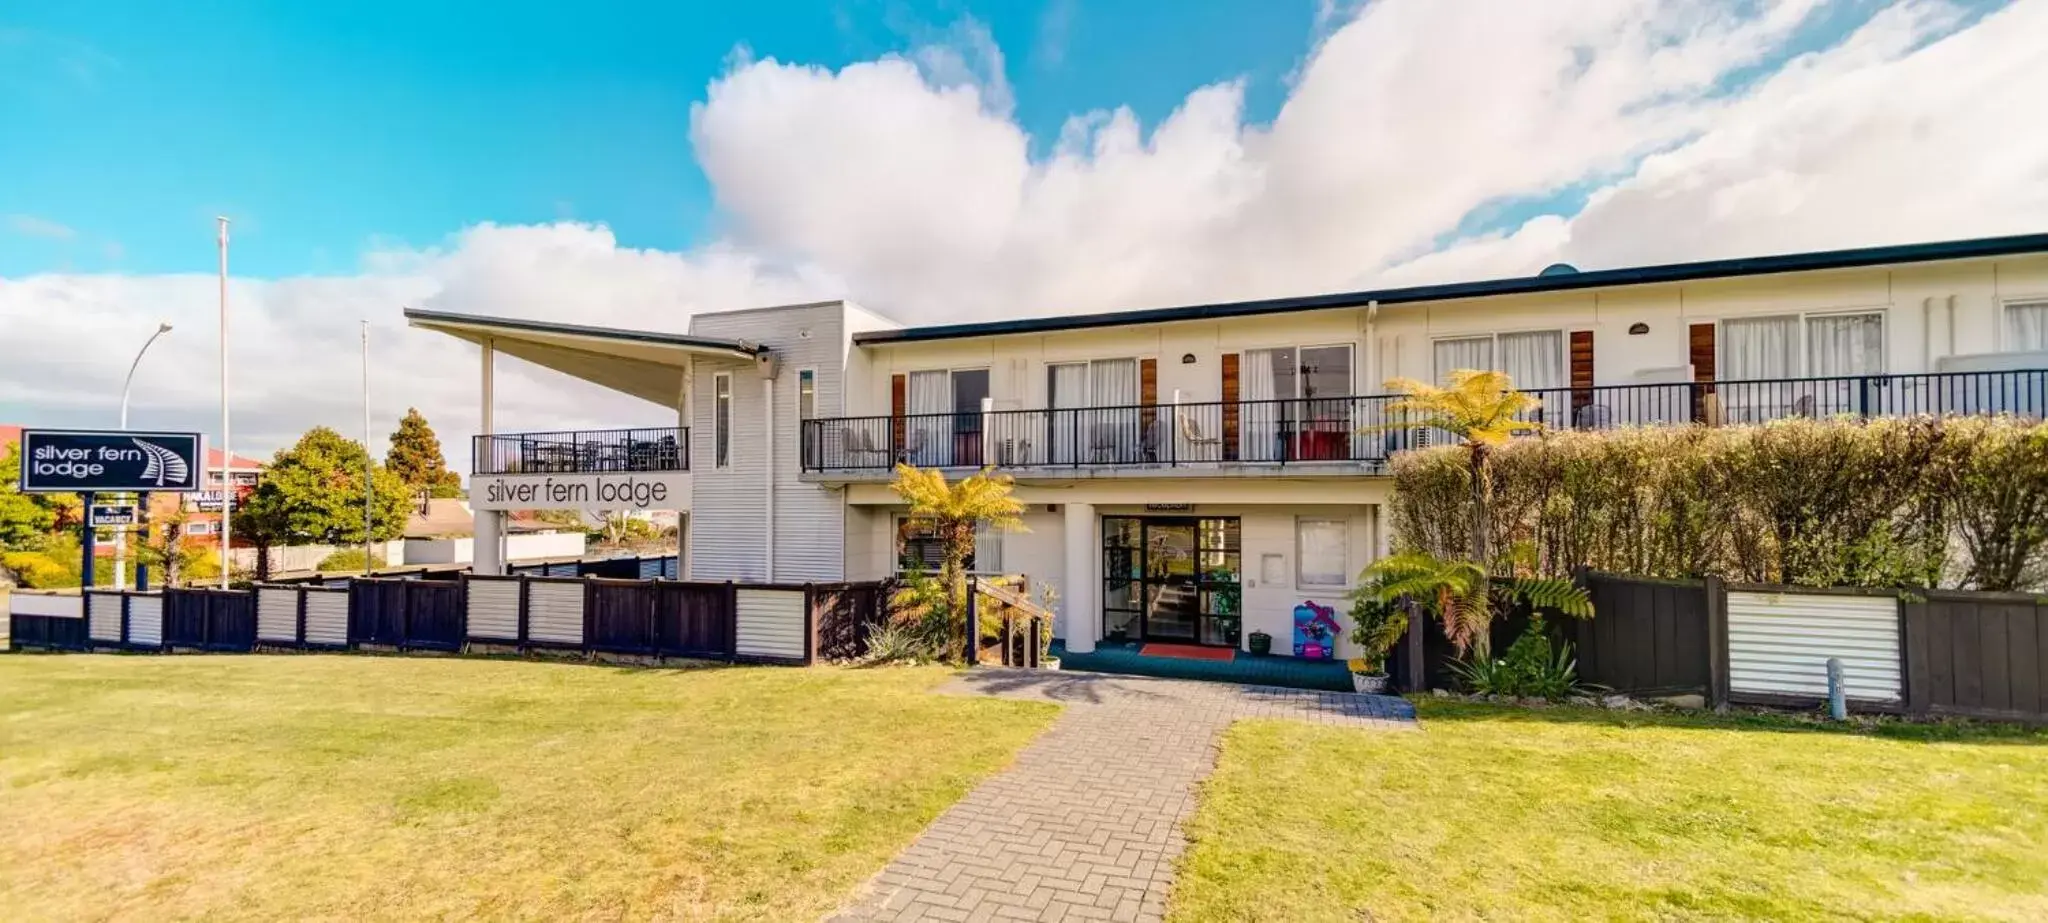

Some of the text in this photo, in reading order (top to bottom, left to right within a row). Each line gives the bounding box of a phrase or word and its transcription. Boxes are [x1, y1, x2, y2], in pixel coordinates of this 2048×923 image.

[35, 445, 141, 461] silver fern
[34, 461, 104, 478] lodge
[487, 477, 667, 508] silver fern lodge
[94, 515, 132, 525] VACANCY
